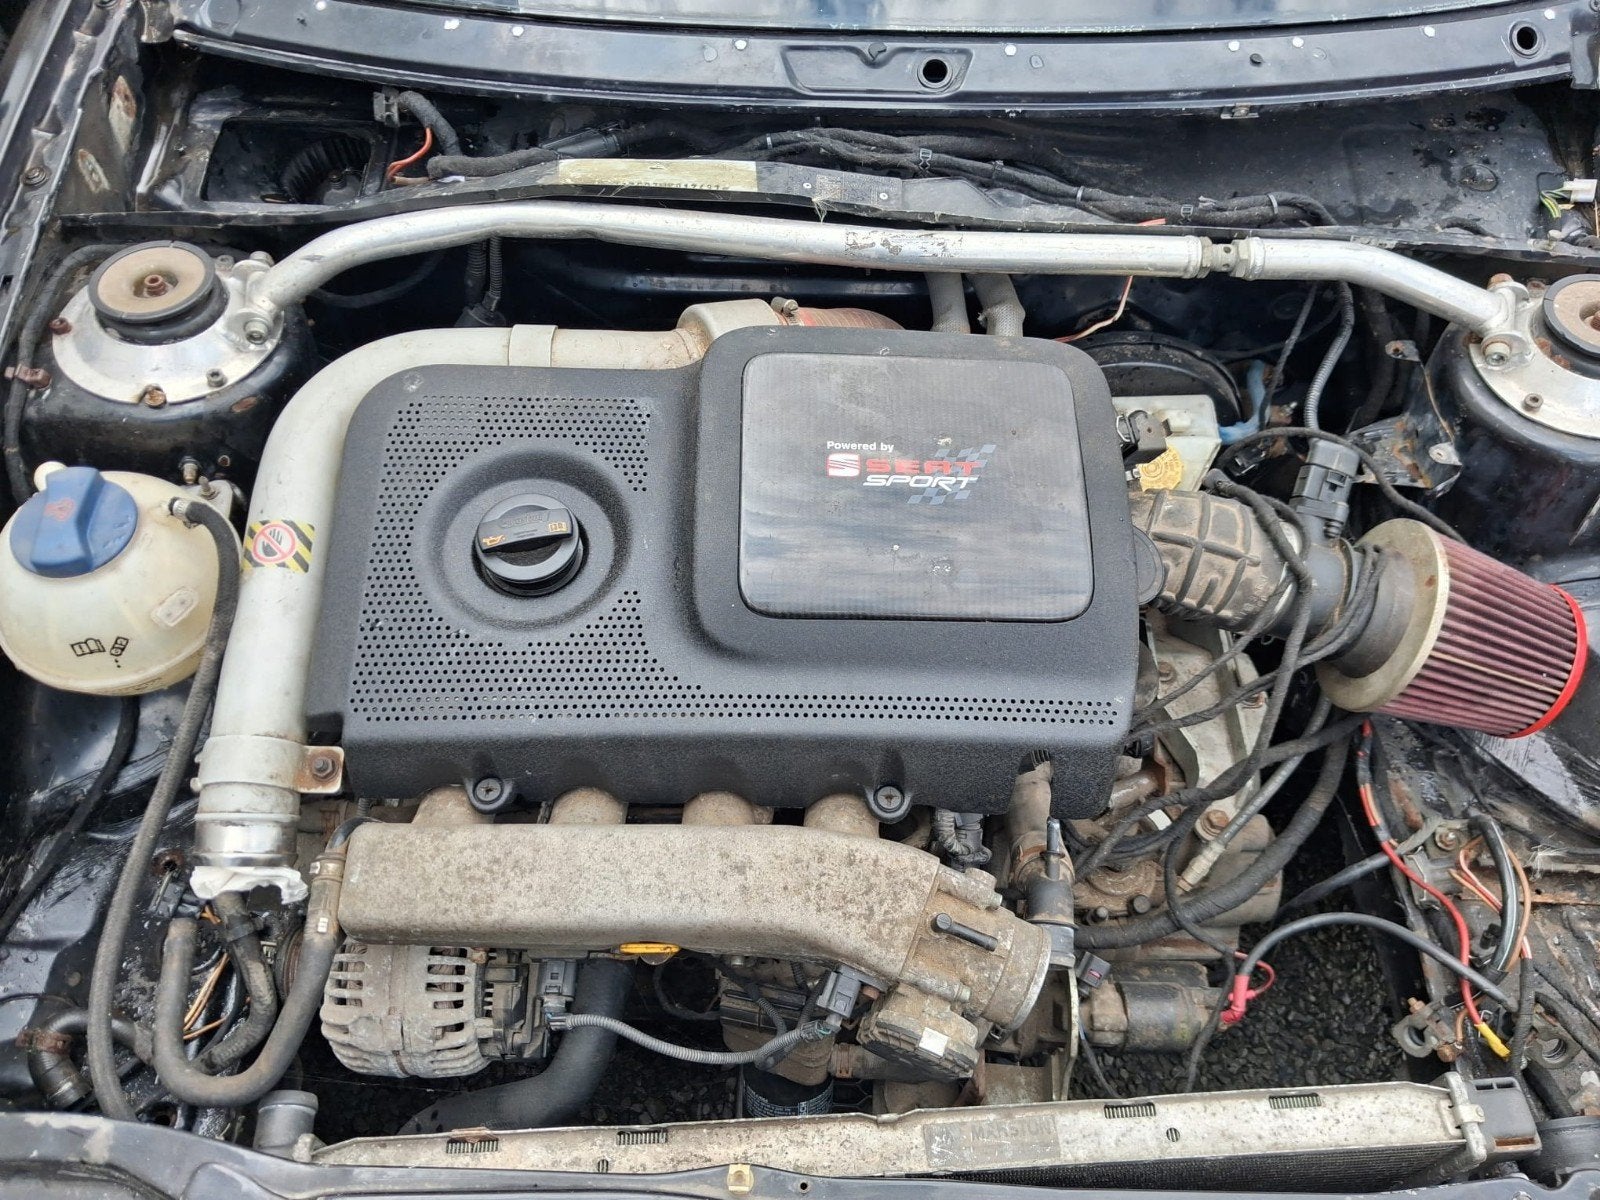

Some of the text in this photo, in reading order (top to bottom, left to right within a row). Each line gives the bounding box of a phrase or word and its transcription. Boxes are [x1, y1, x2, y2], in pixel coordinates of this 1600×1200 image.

[826, 440, 894, 453] Powered by
[865, 458, 984, 475] SEAT
[863, 474, 979, 491] SPORT
